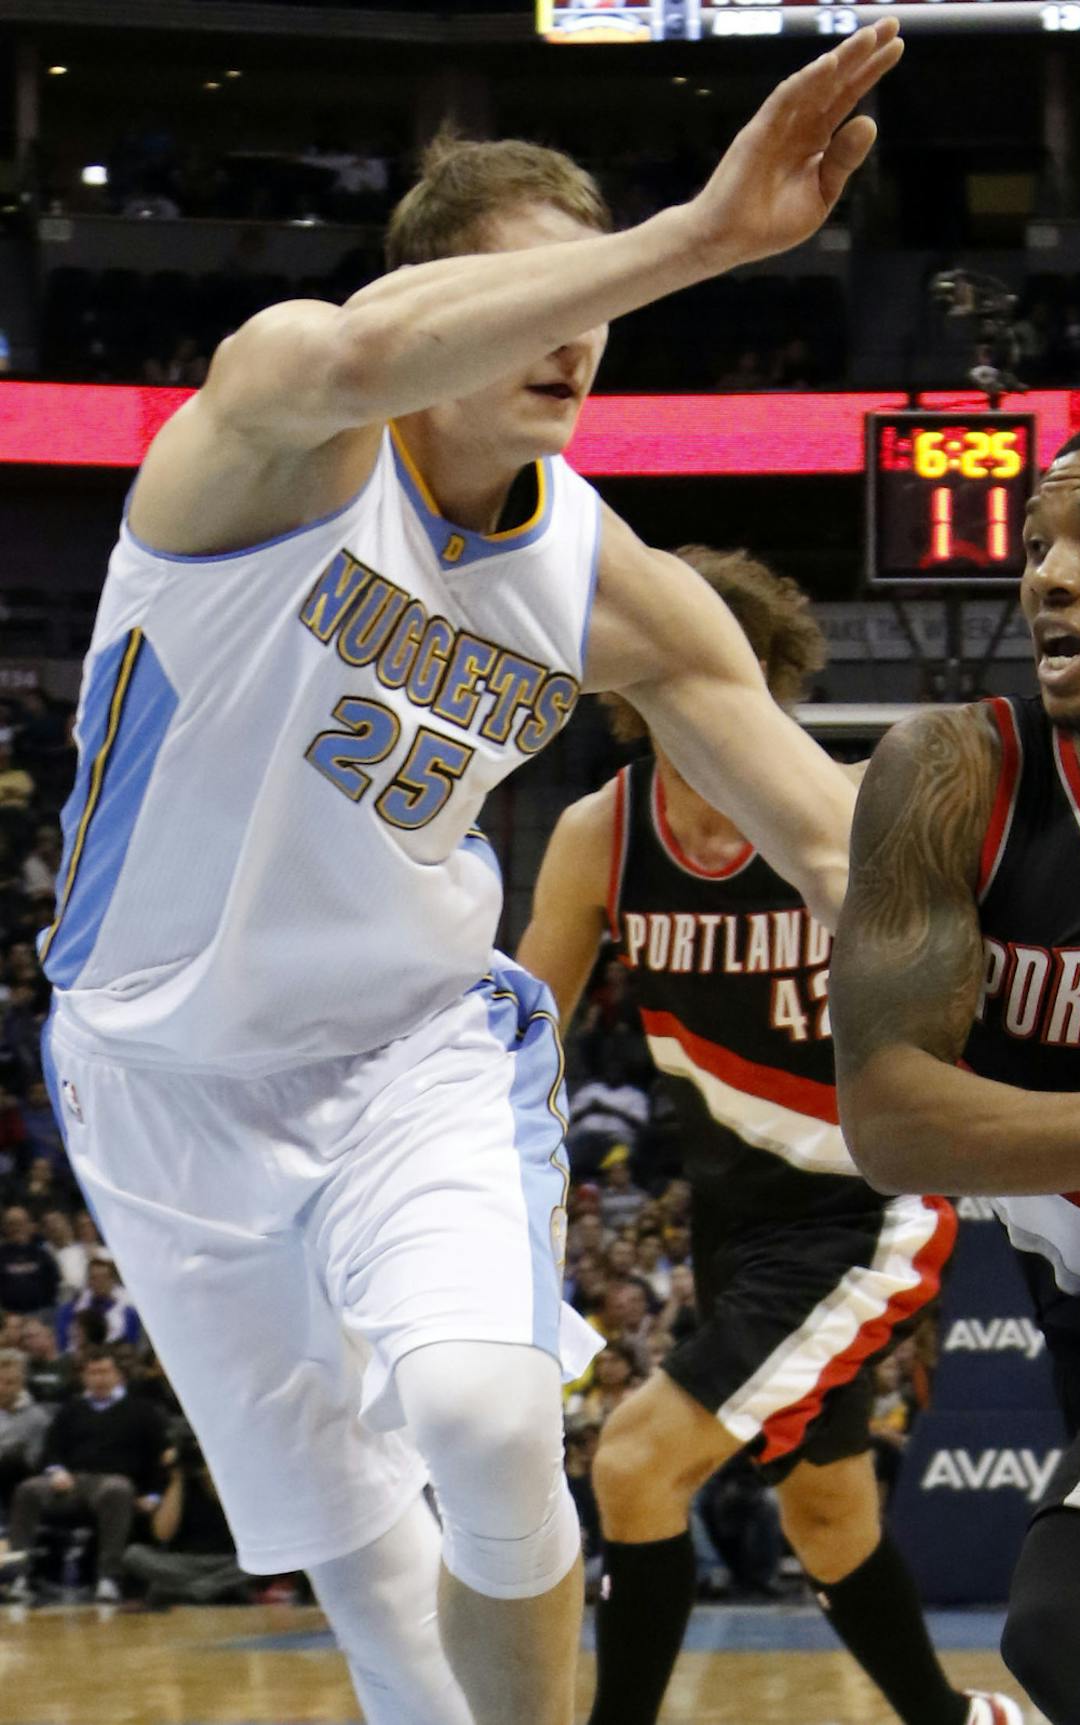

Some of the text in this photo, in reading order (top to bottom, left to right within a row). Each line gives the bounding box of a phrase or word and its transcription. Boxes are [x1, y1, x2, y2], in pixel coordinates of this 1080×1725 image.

[817, 10, 855, 32] 13
[915, 432, 1021, 478] 6:25
[932, 487, 1008, 559] 11
[300, 548, 579, 753] NUGGETS
[304, 695, 475, 829] 25
[624, 909, 833, 974] PORTLAND
